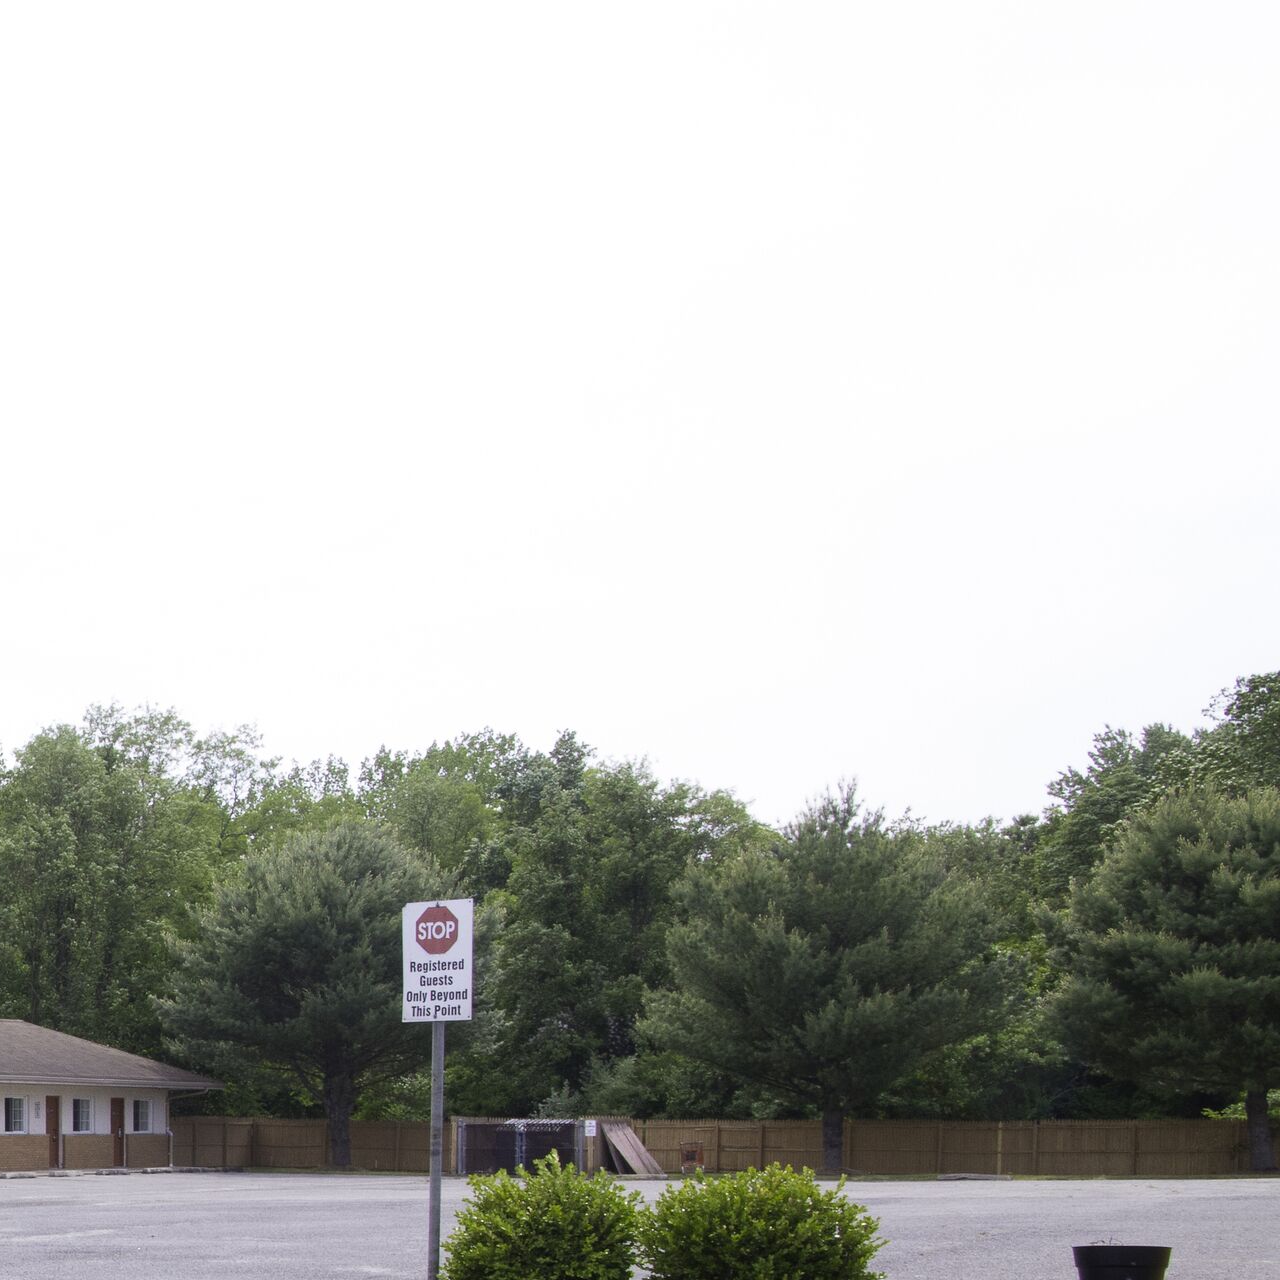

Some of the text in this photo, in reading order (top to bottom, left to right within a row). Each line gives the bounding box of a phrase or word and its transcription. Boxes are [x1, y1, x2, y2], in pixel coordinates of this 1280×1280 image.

[418, 921, 455, 940] STOP
[410, 959, 464, 973] Registered
[419, 975, 454, 987] Guests
[406, 989, 468, 1003] Only Beyond
[411, 1004, 461, 1017] This Point
